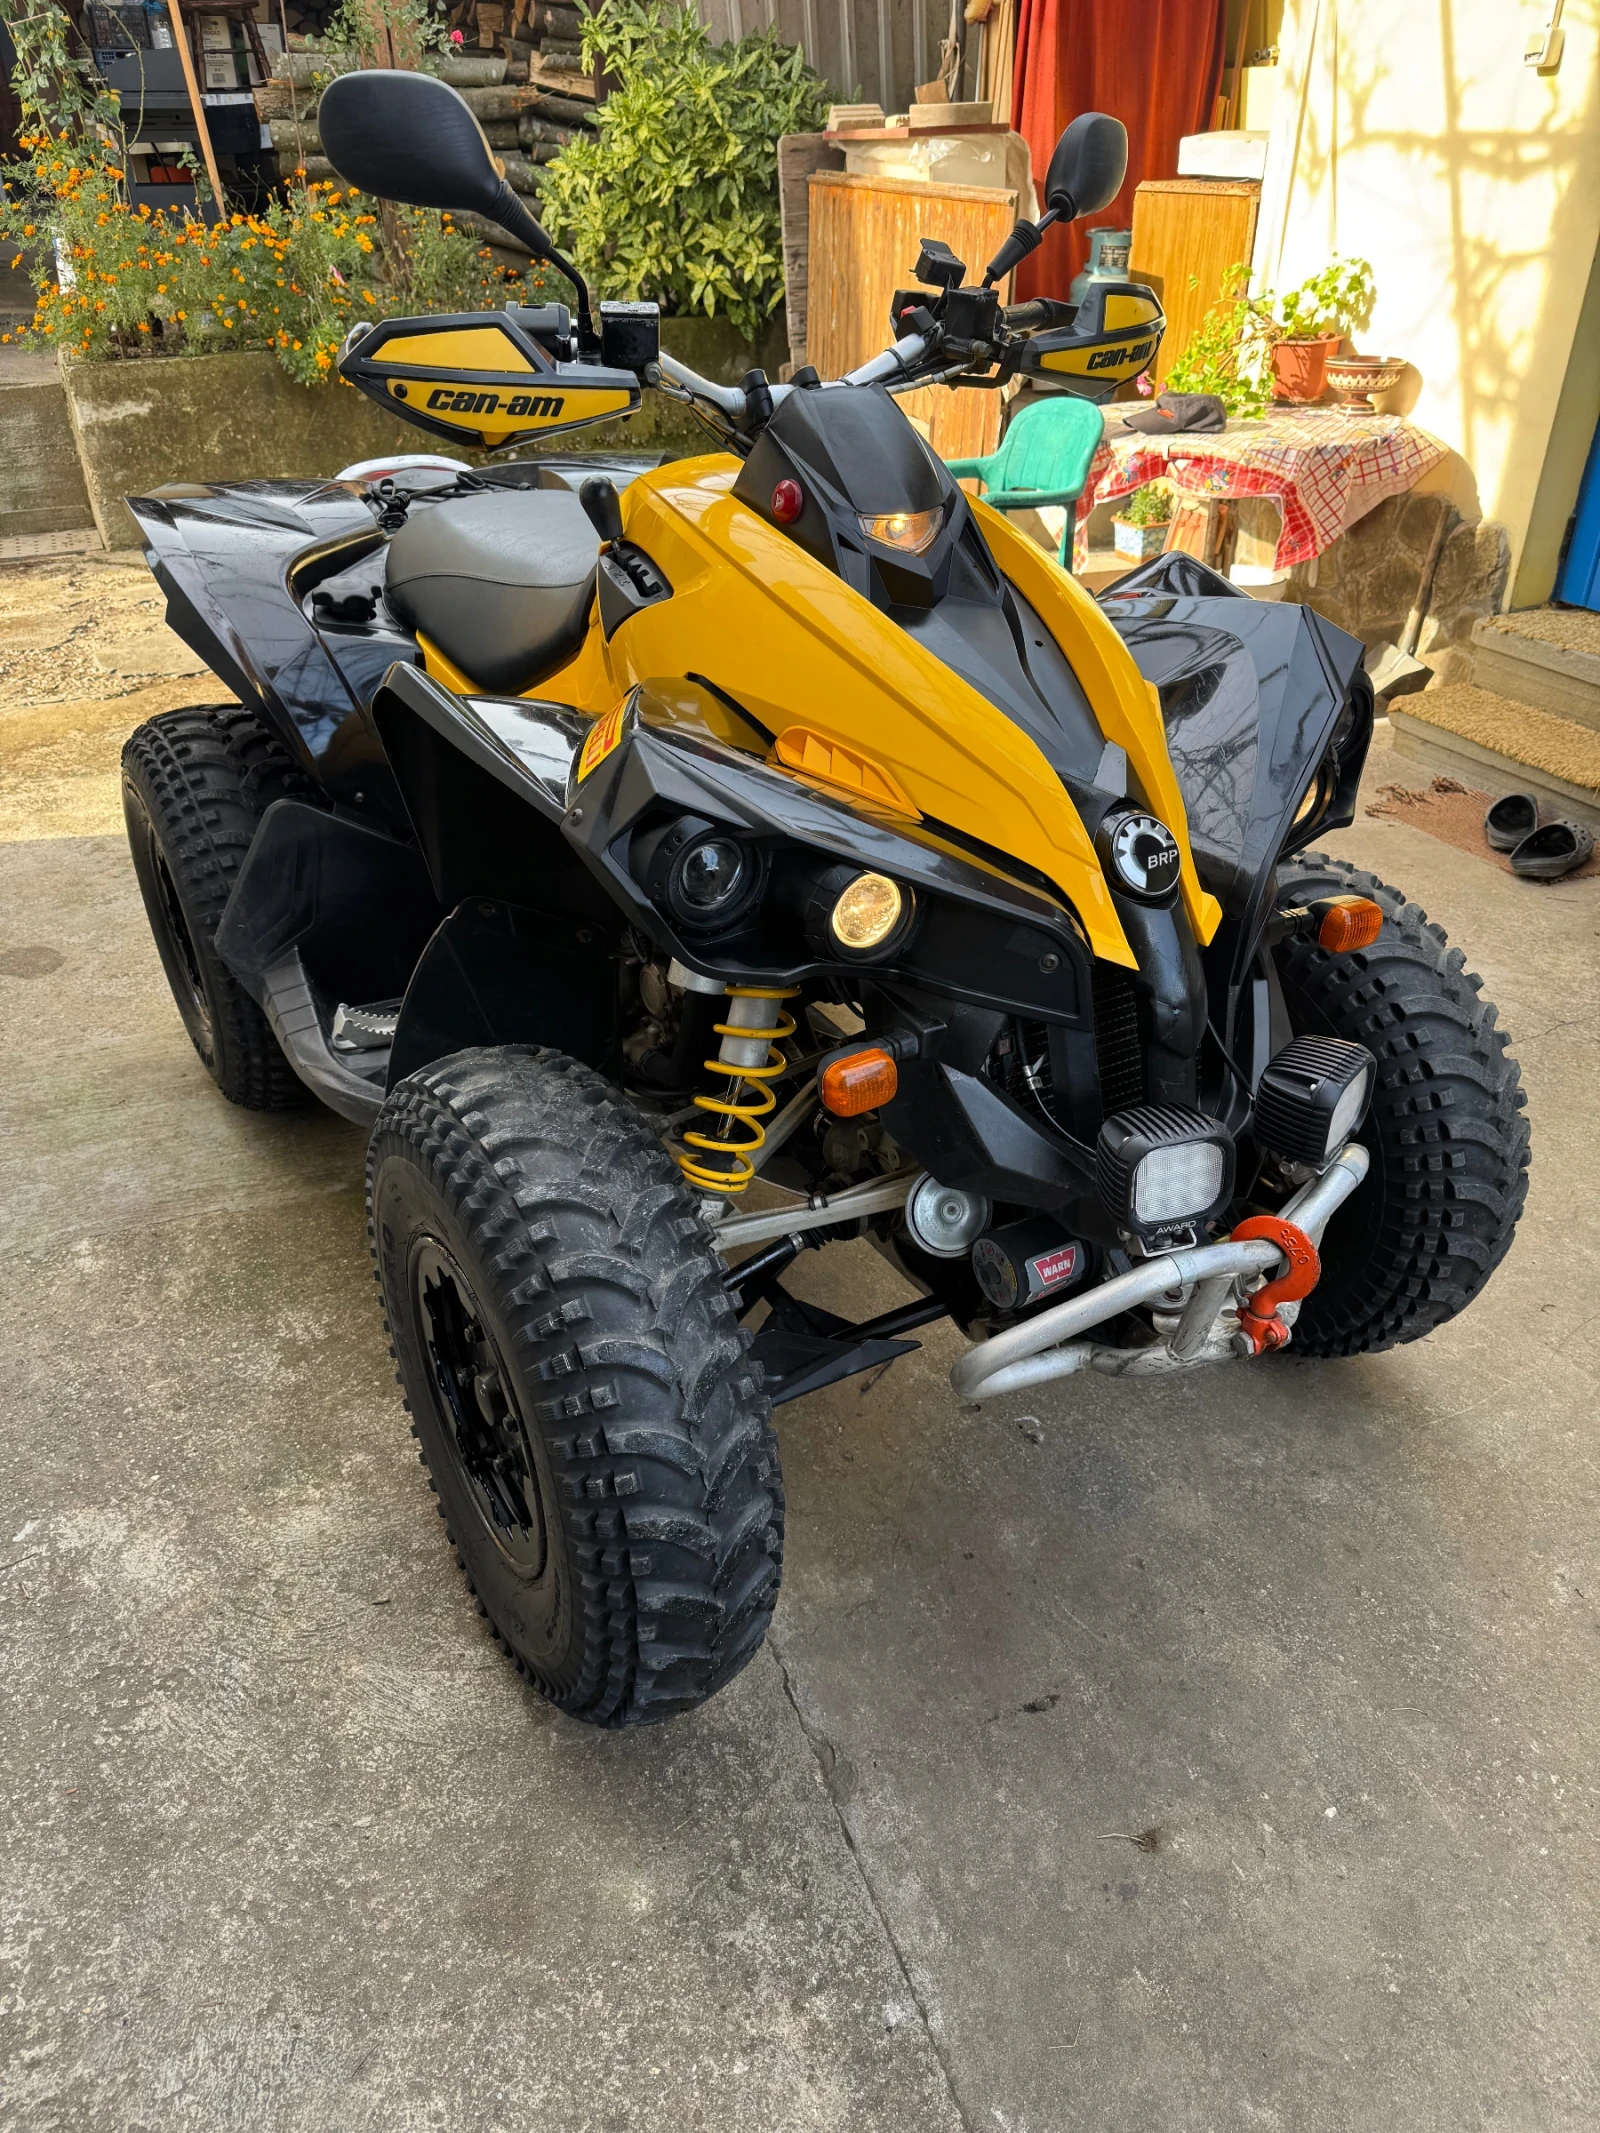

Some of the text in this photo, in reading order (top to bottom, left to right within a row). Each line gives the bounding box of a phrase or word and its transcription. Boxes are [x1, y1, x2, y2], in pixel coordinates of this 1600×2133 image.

[1087, 341, 1152, 370] can-am
[426, 389, 565, 417] can-am
[1148, 849, 1178, 869] BRP
[1156, 1220, 1197, 1235] AWARD
[1043, 1258, 1071, 1277] WARN
